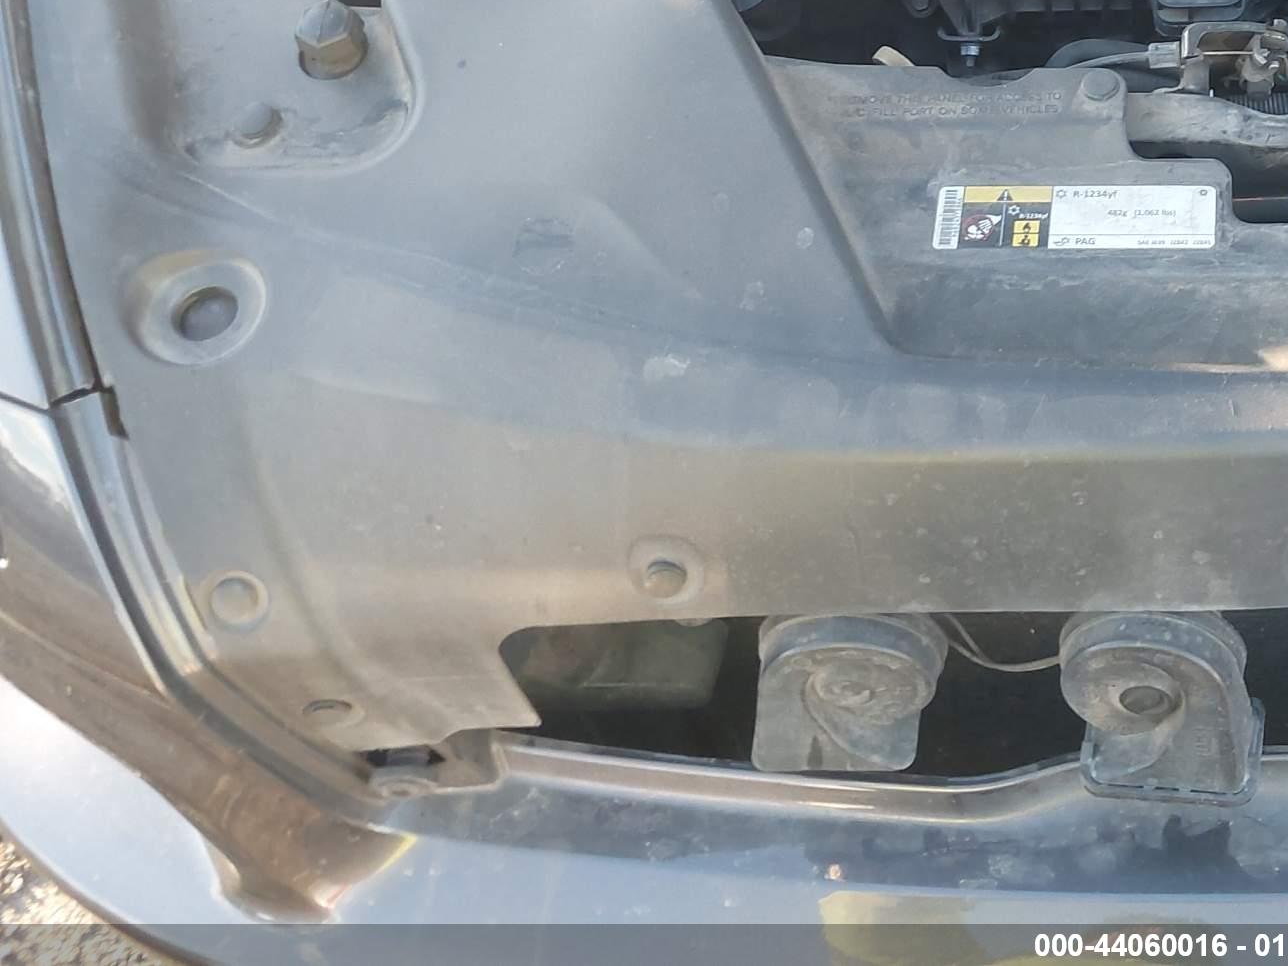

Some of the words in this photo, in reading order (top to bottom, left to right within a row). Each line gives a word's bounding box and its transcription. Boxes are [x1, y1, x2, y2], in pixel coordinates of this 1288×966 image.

[1046, 91, 1062, 101] TO
[872, 107, 897, 117] FILL
[903, 106, 935, 117] PORT
[939, 106, 957, 116] ON
[1072, 189, 1119, 200] R-1234yf
[1074, 237, 1096, 246] PAG
